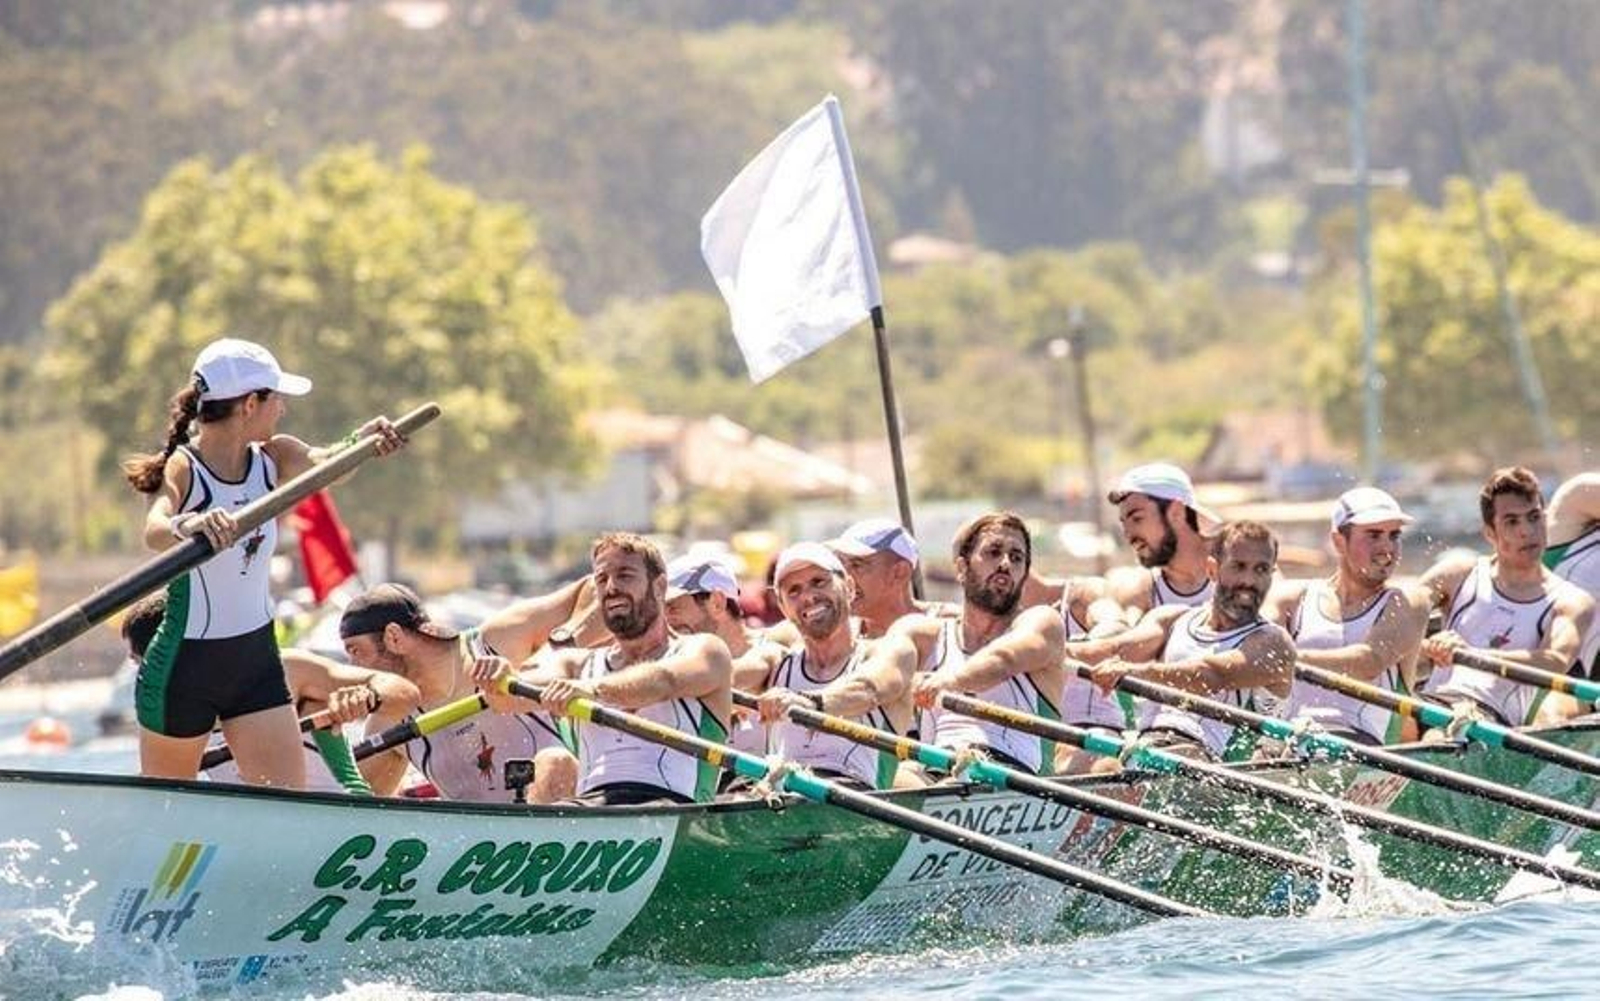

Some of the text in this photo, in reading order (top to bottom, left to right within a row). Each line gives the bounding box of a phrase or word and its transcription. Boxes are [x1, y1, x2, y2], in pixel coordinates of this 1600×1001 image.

[437, 837, 662, 897] CORUXO
[909, 851, 960, 881] DE
[266, 895, 348, 942] A
